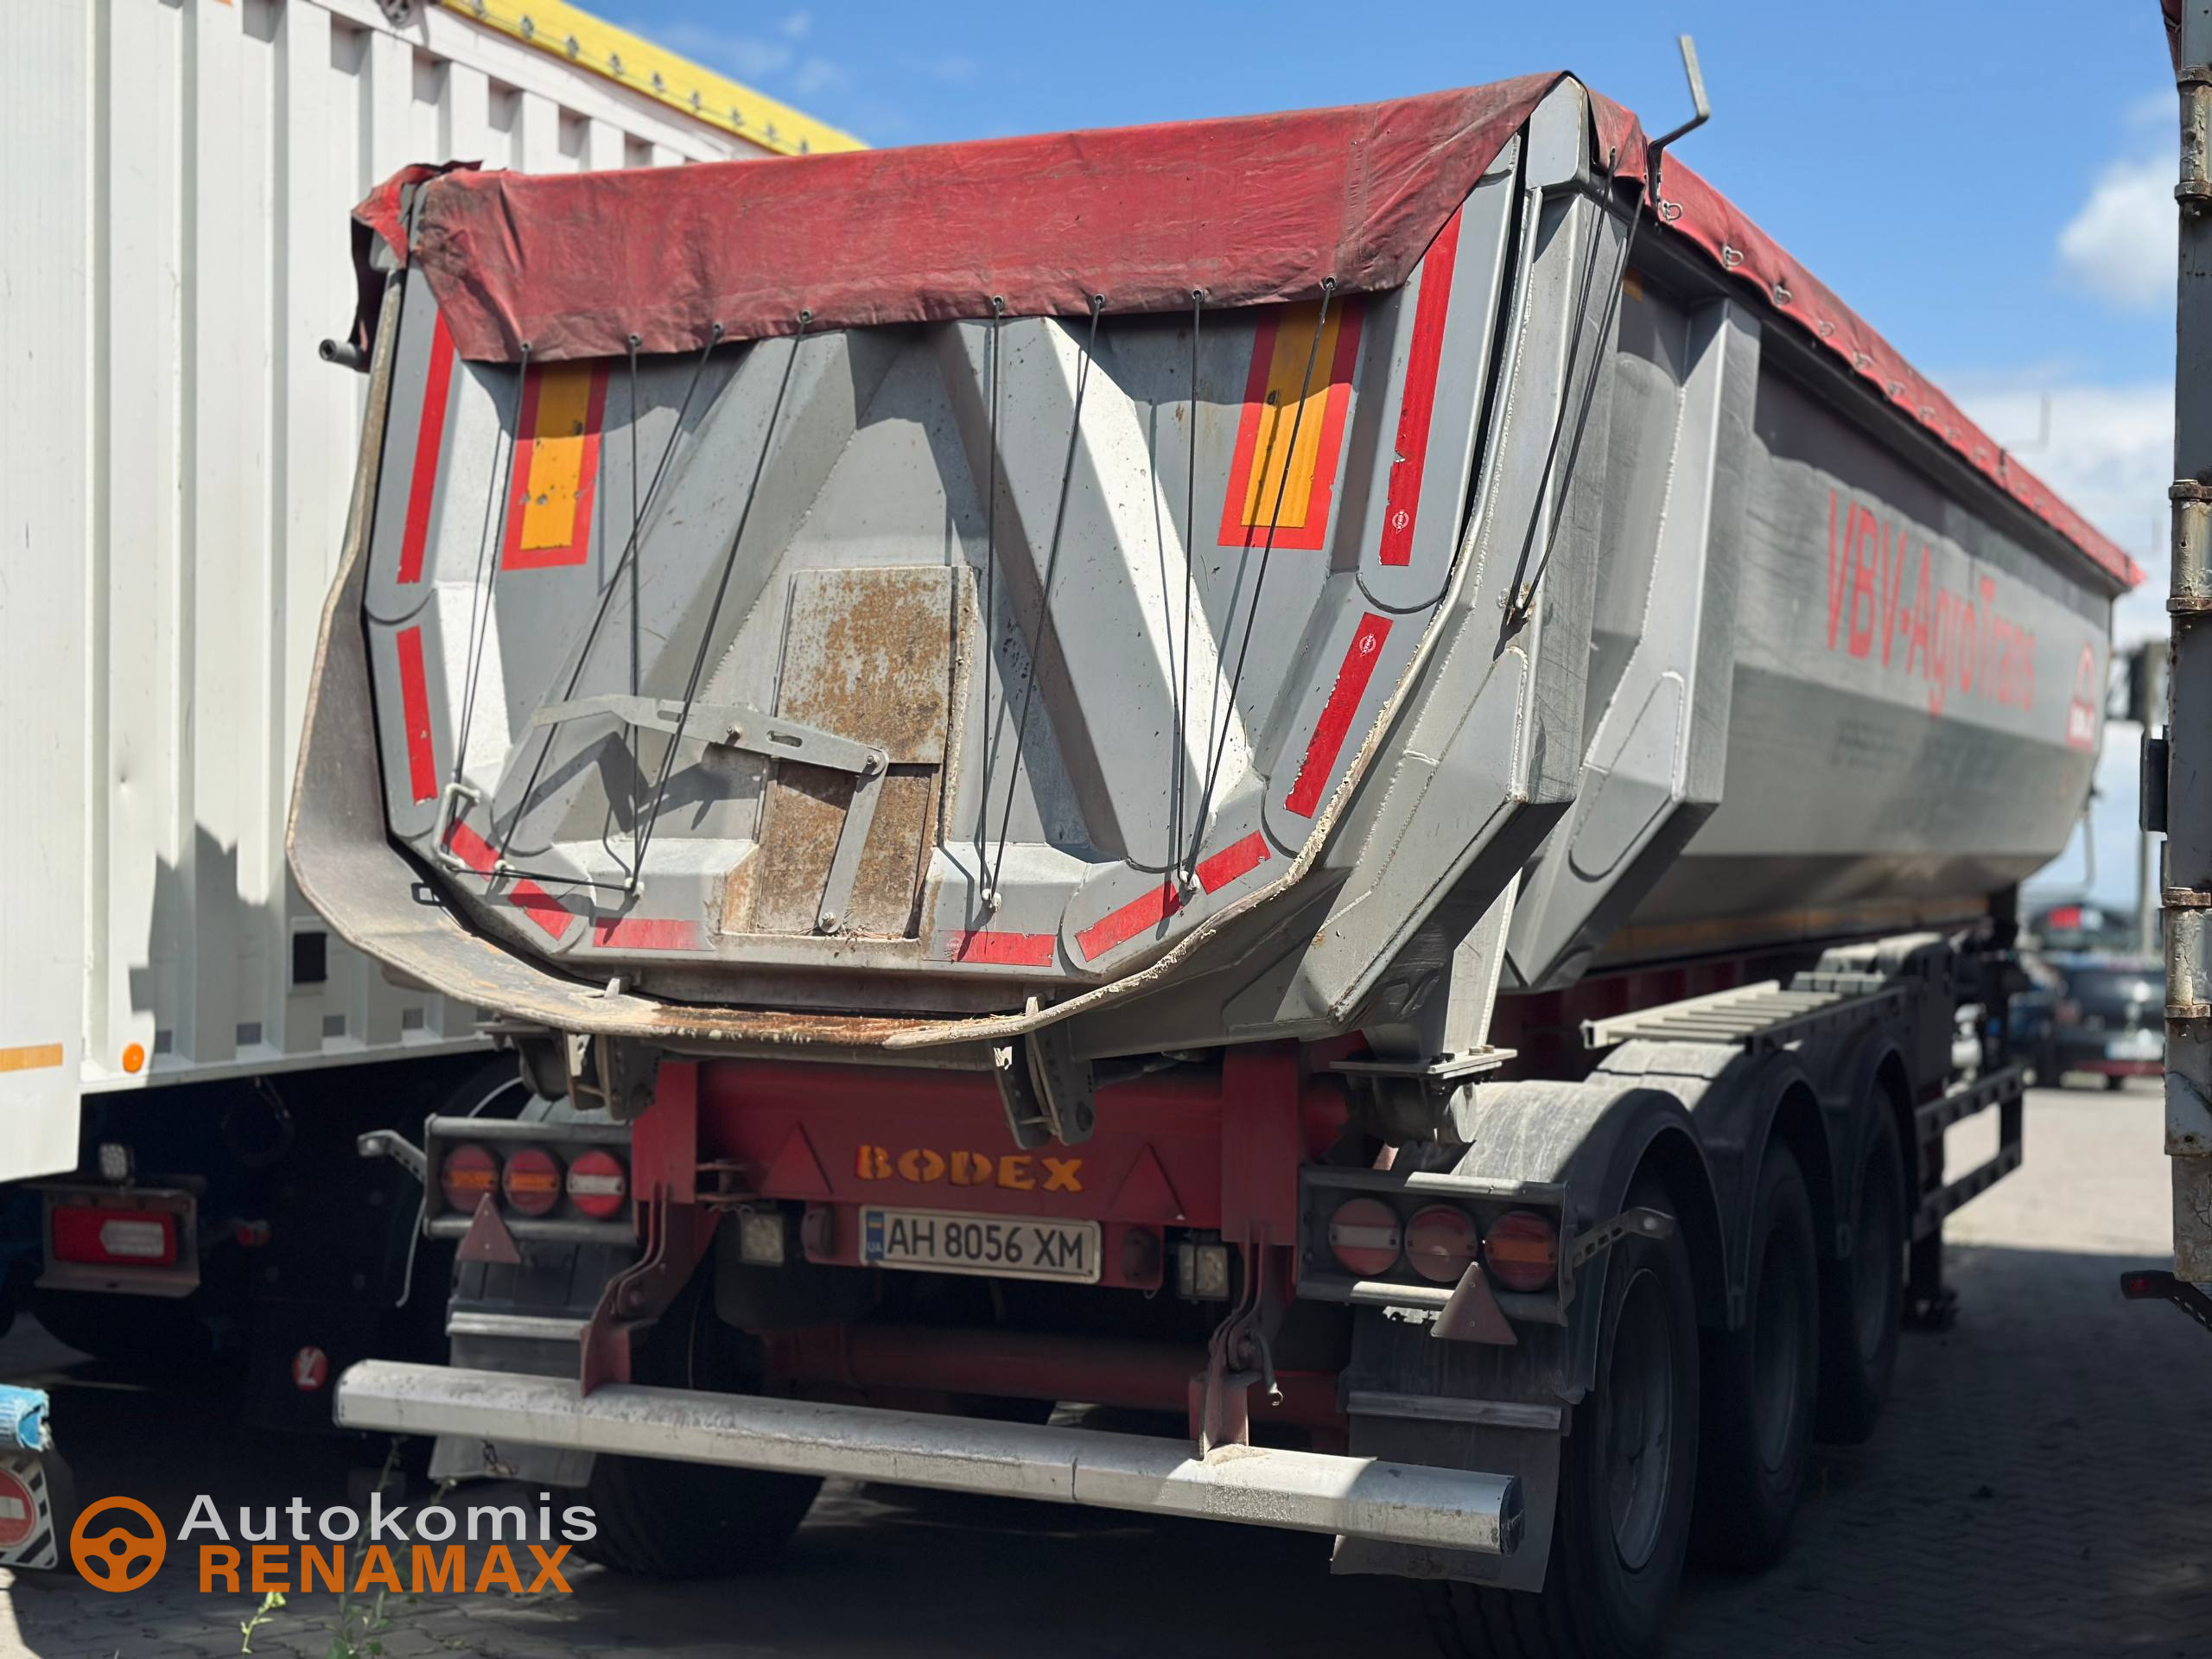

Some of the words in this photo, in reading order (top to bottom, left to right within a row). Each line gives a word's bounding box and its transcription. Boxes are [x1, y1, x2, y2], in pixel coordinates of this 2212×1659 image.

[855, 1145, 1084, 1192] BODEX
[887, 1218, 935, 1257] AH
[944, 1223, 1023, 1264] 8056
[1033, 1229, 1084, 1269] XM
